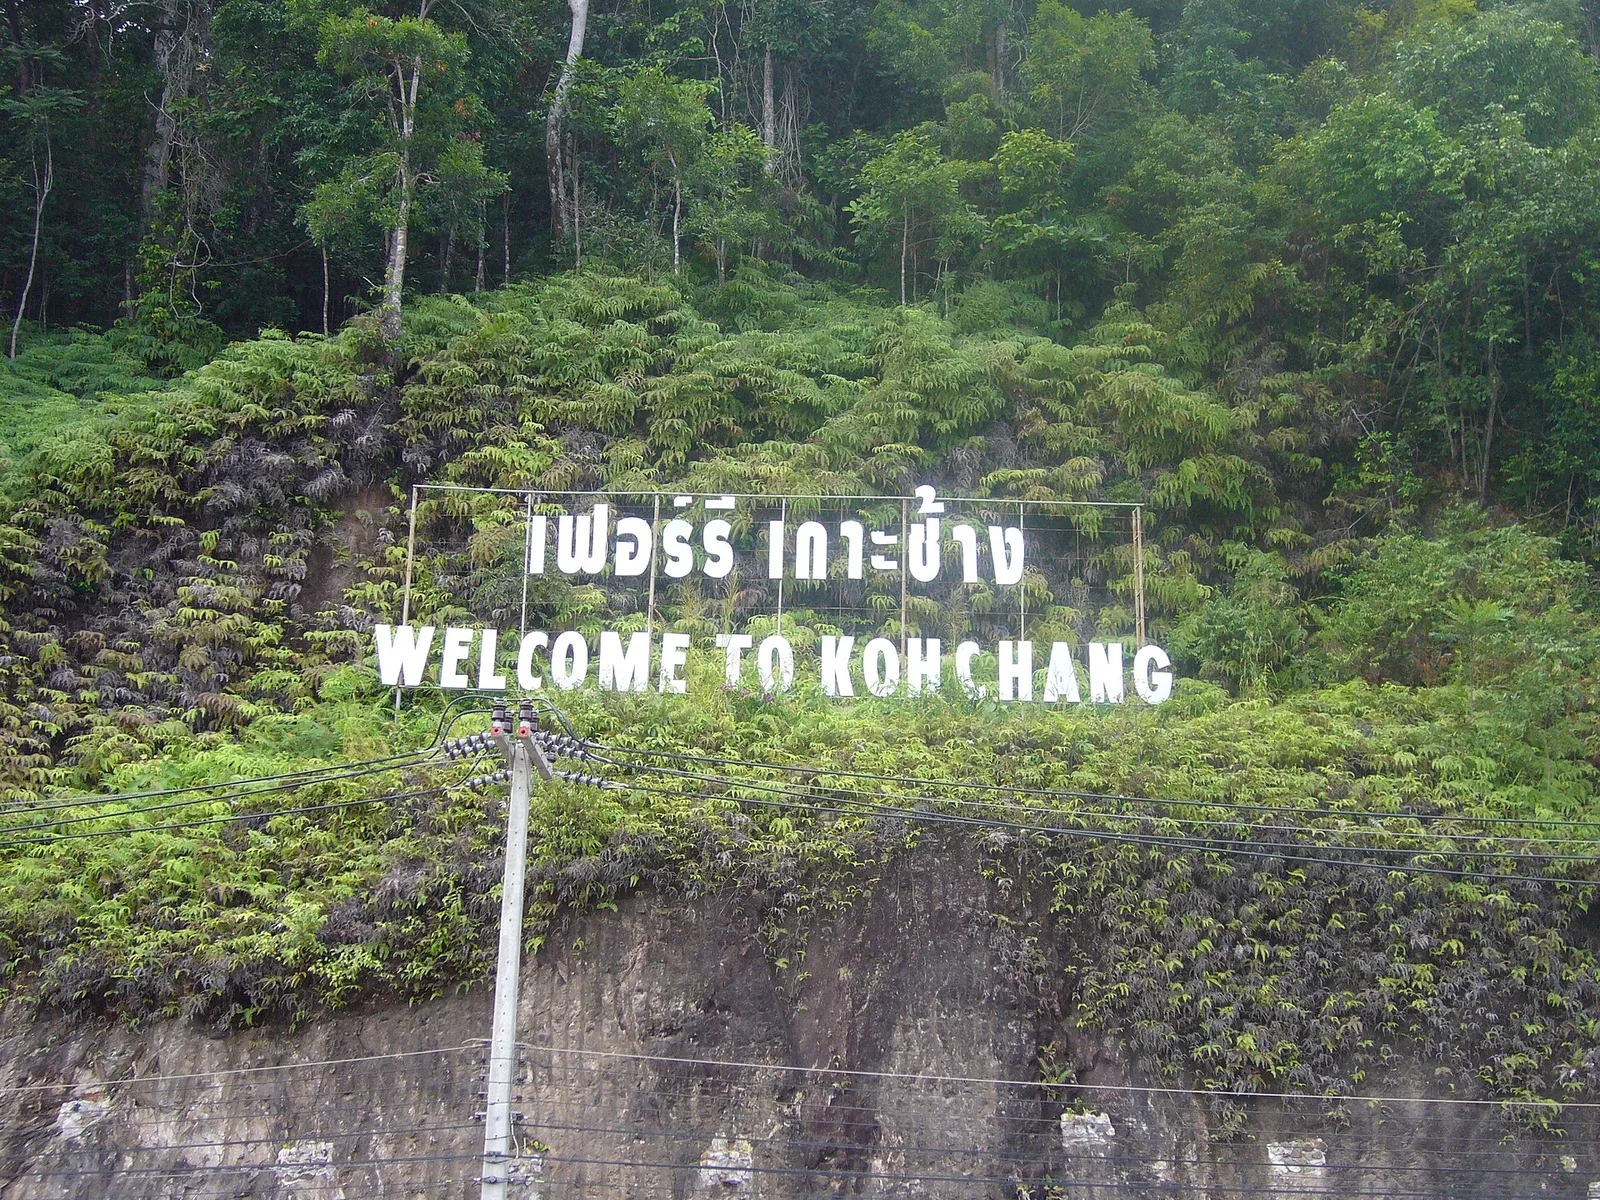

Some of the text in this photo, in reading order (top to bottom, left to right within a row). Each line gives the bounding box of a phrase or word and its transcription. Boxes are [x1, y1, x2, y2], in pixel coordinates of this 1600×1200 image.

[768, 484, 1025, 585] เกาะช้าง
[374, 623, 690, 694] WELCOME
[715, 633, 794, 694] TO
